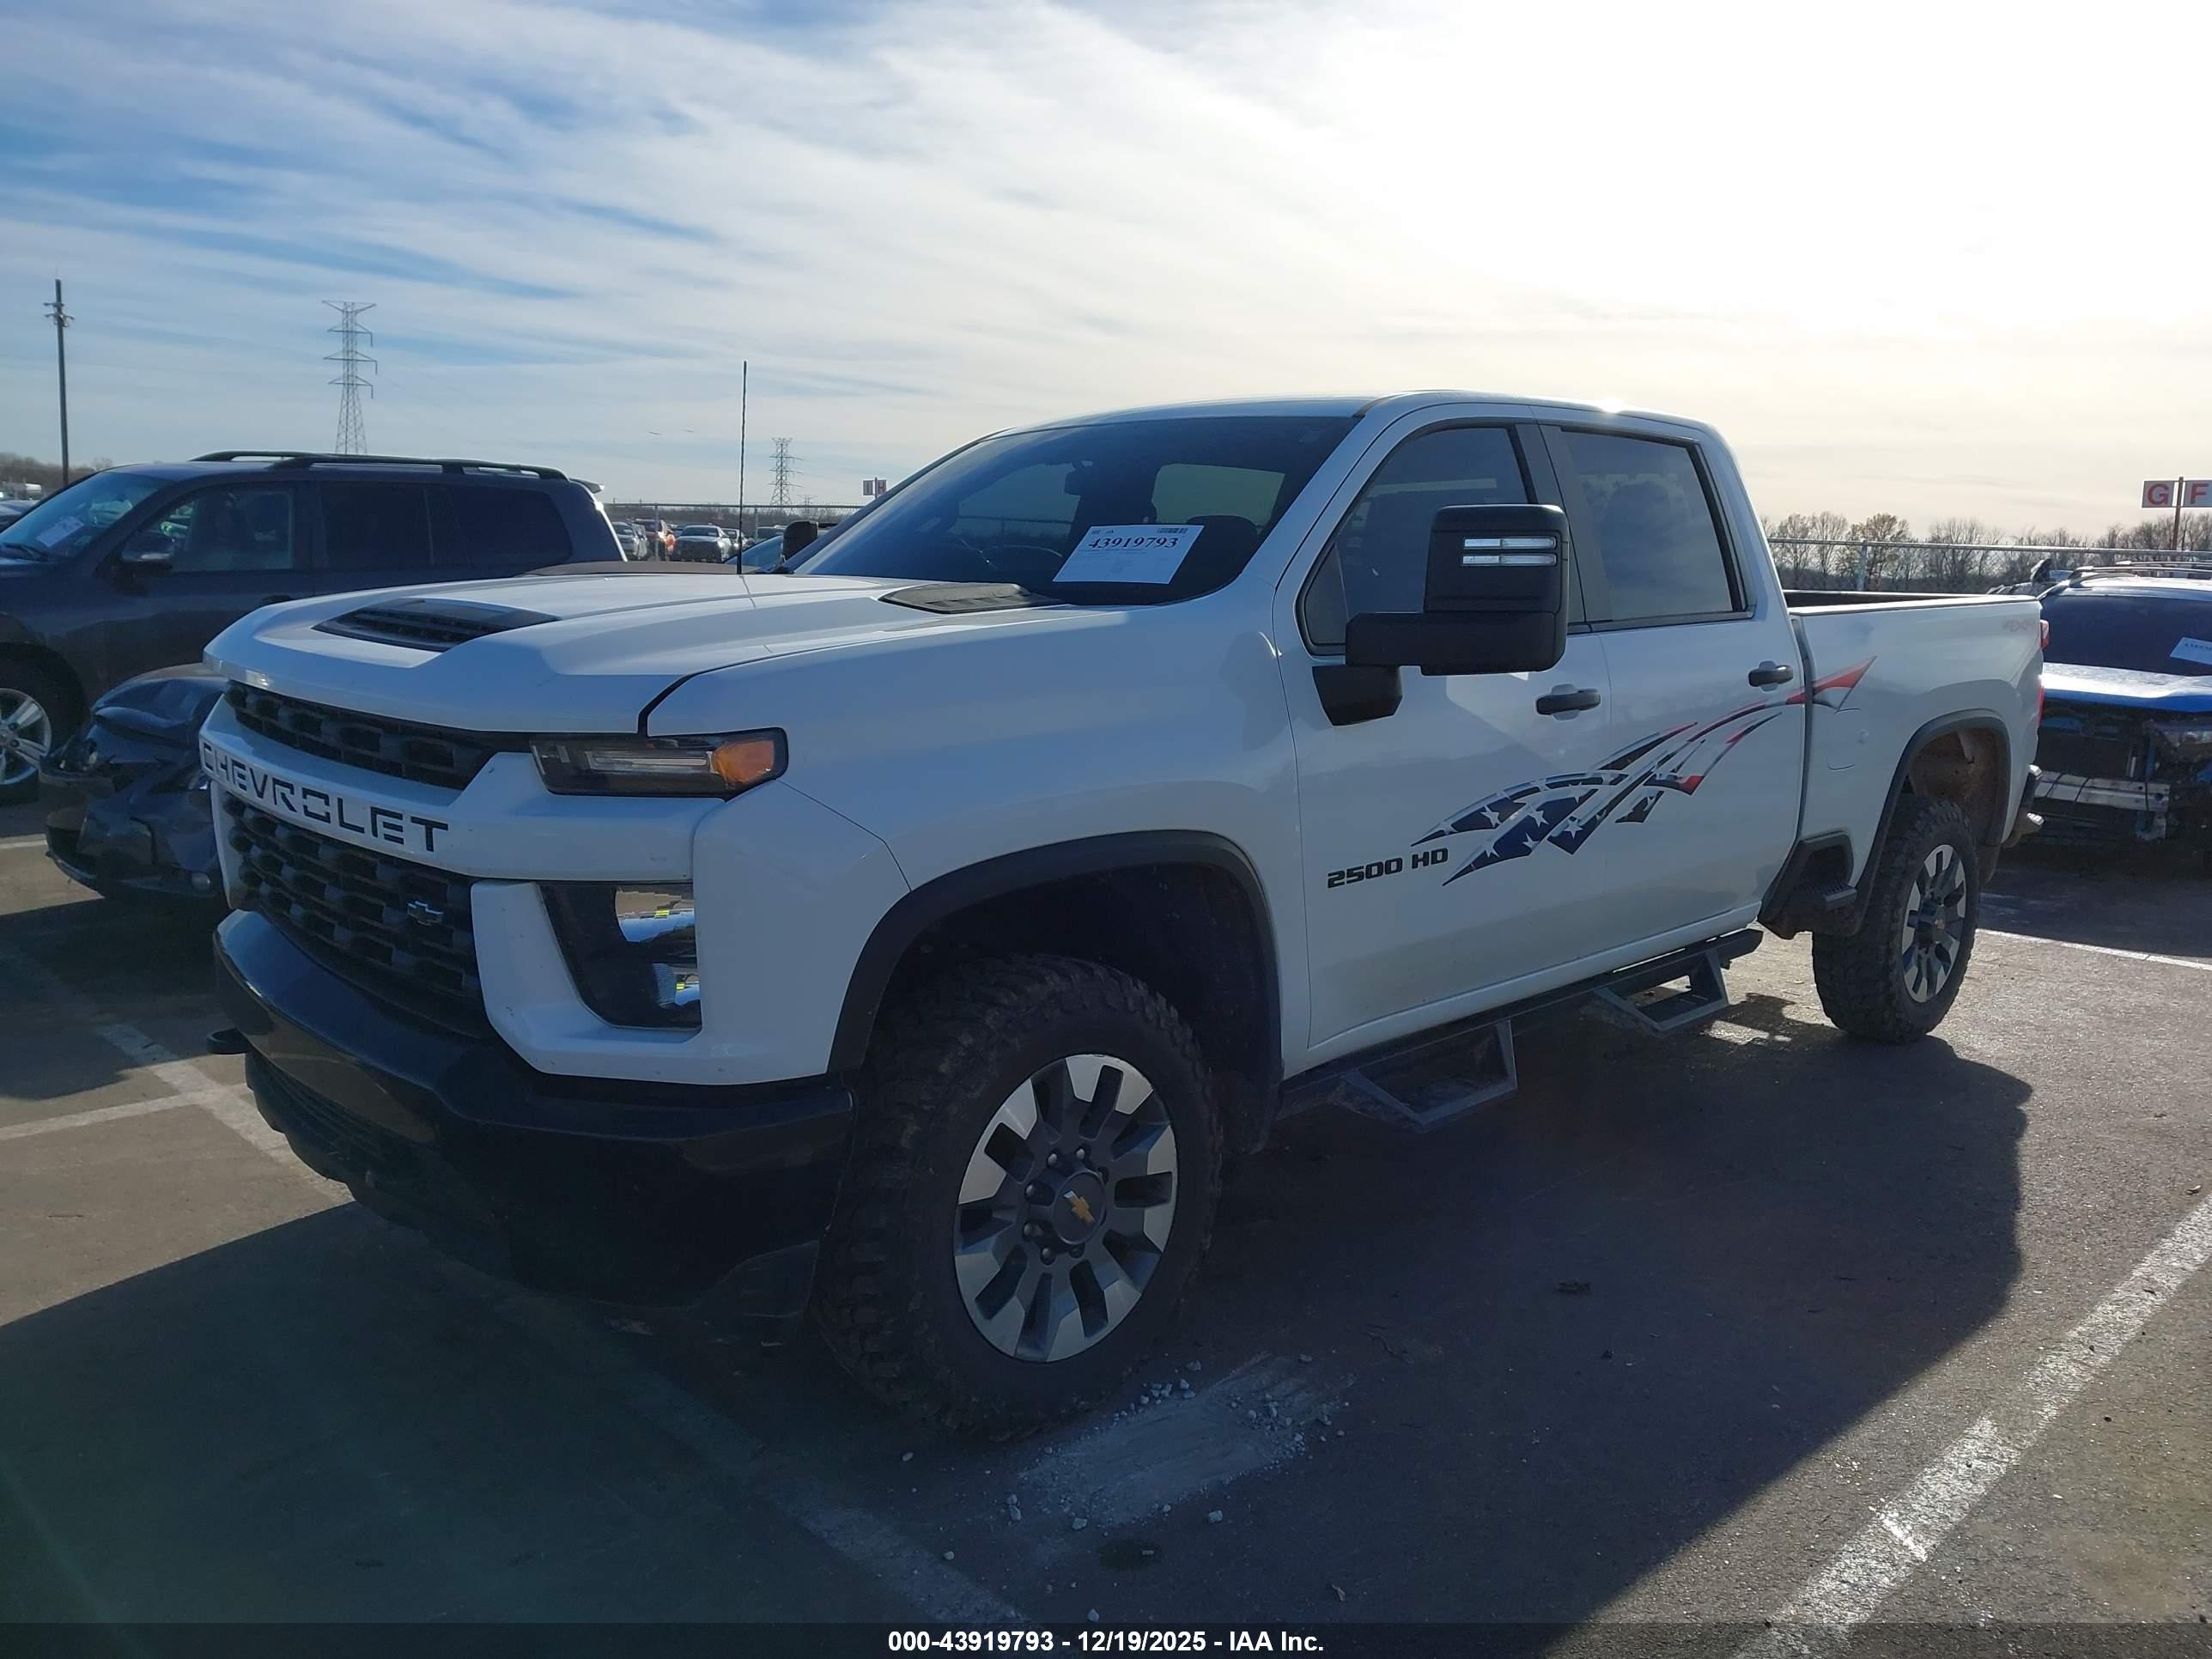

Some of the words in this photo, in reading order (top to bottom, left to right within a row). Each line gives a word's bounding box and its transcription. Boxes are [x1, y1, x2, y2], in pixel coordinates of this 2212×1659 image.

[2148, 483, 2169, 505] G
[2190, 483, 2209, 504] F
[1087, 537, 1179, 549] 43919793
[201, 741, 449, 853] CHEVROLET
[1328, 857, 1403, 888] 2500
[1412, 848, 1449, 869] HD
